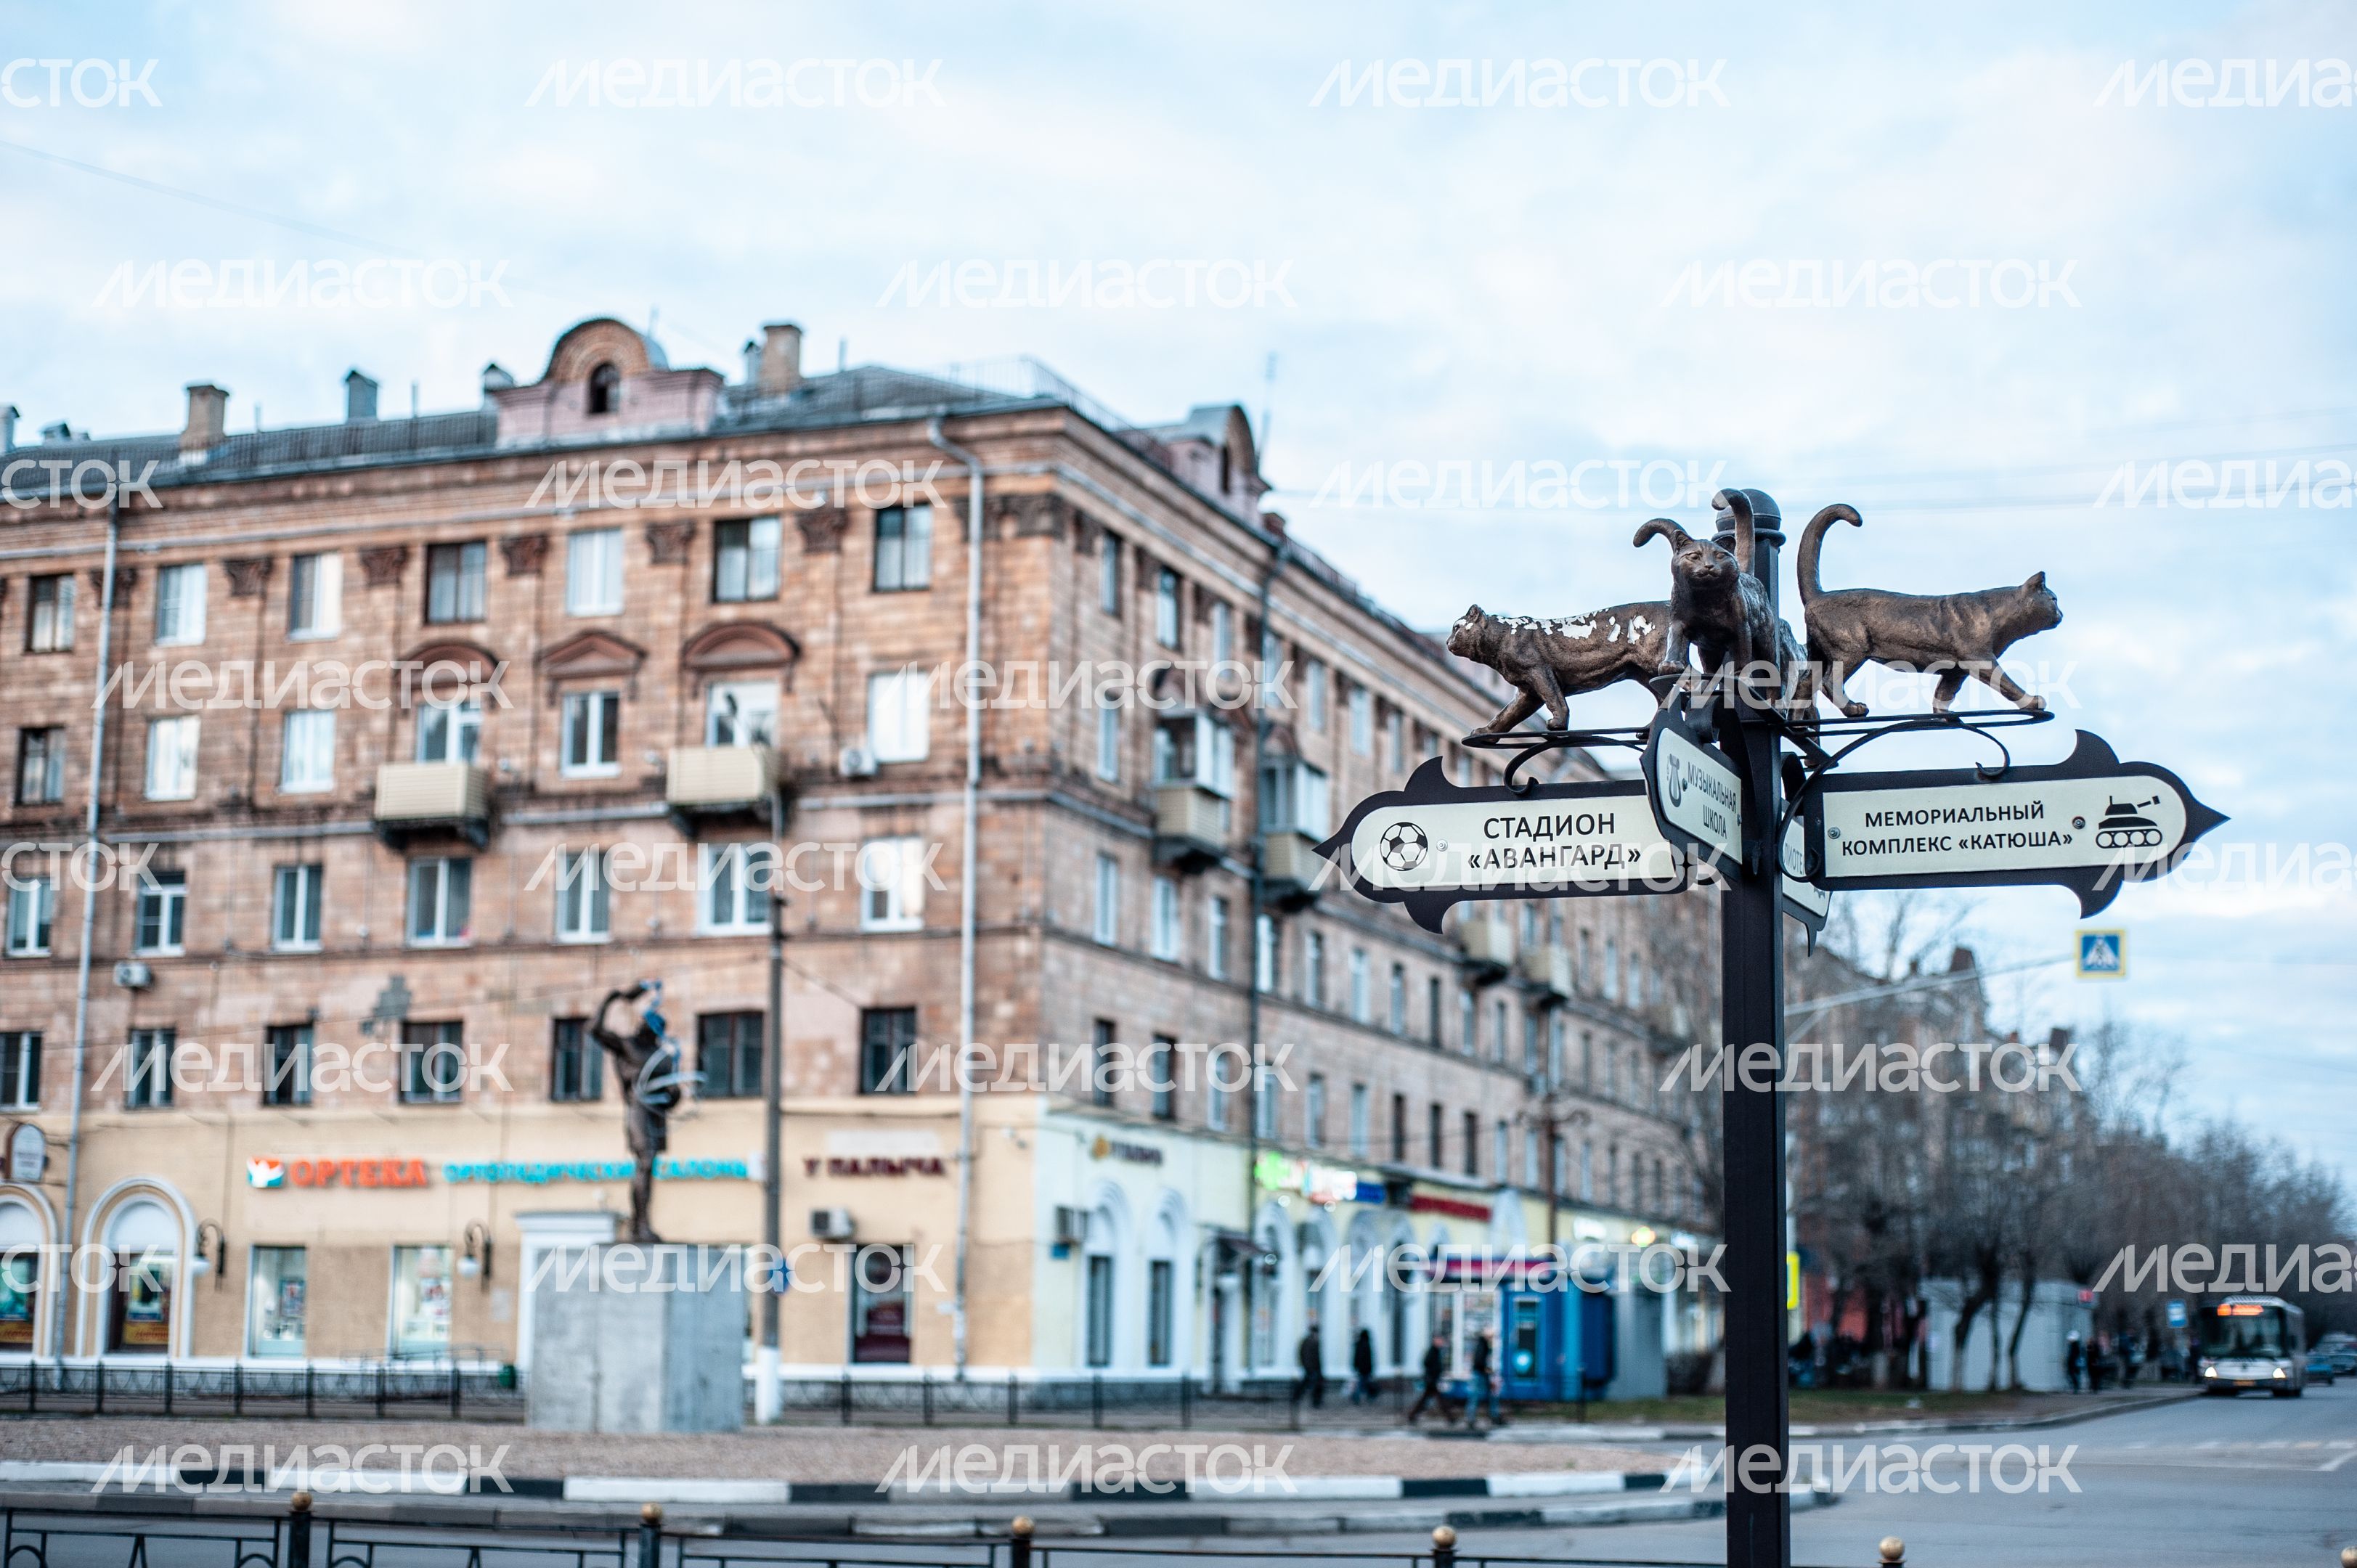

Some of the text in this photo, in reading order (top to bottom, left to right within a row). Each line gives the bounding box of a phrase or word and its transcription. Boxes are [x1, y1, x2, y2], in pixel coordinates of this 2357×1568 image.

[1687, 761, 1737, 814] МУЗЫКАЛЬНАЯ
[1483, 812, 1615, 842] СТАДИОН
[1702, 804, 1727, 840] ШКОЛА
[1864, 800, 2045, 828] МЕМОРИАЛЬНЫЙ
[1467, 843, 1641, 870] «АВАНГАРД»
[1841, 830, 2074, 857] КОМПЛЕКС «КАТЮША»
